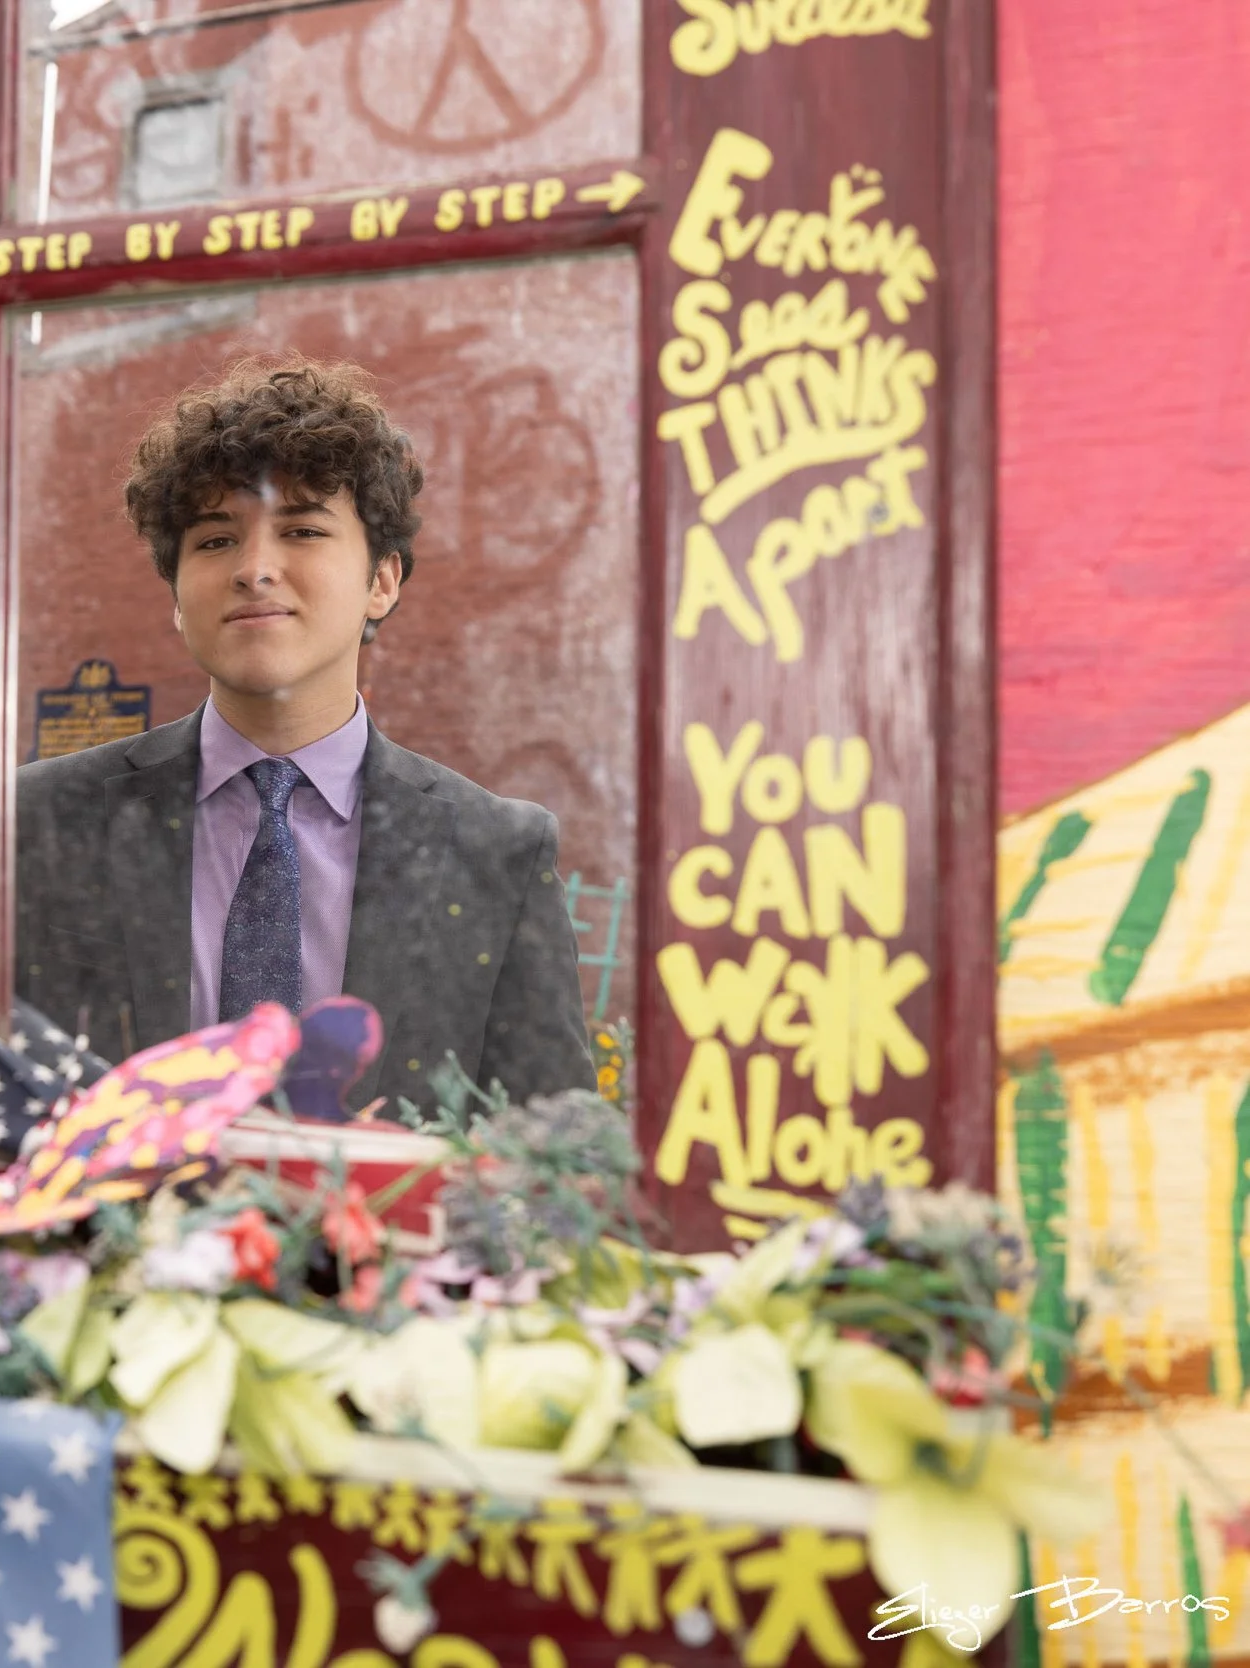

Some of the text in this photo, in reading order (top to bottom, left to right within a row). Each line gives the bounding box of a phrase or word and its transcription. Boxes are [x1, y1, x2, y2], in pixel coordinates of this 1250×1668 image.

[125, 221, 180, 262] BY
[203, 207, 314, 256] STEP
[351, 197, 408, 241] BY
[435, 178, 566, 233] STEP
